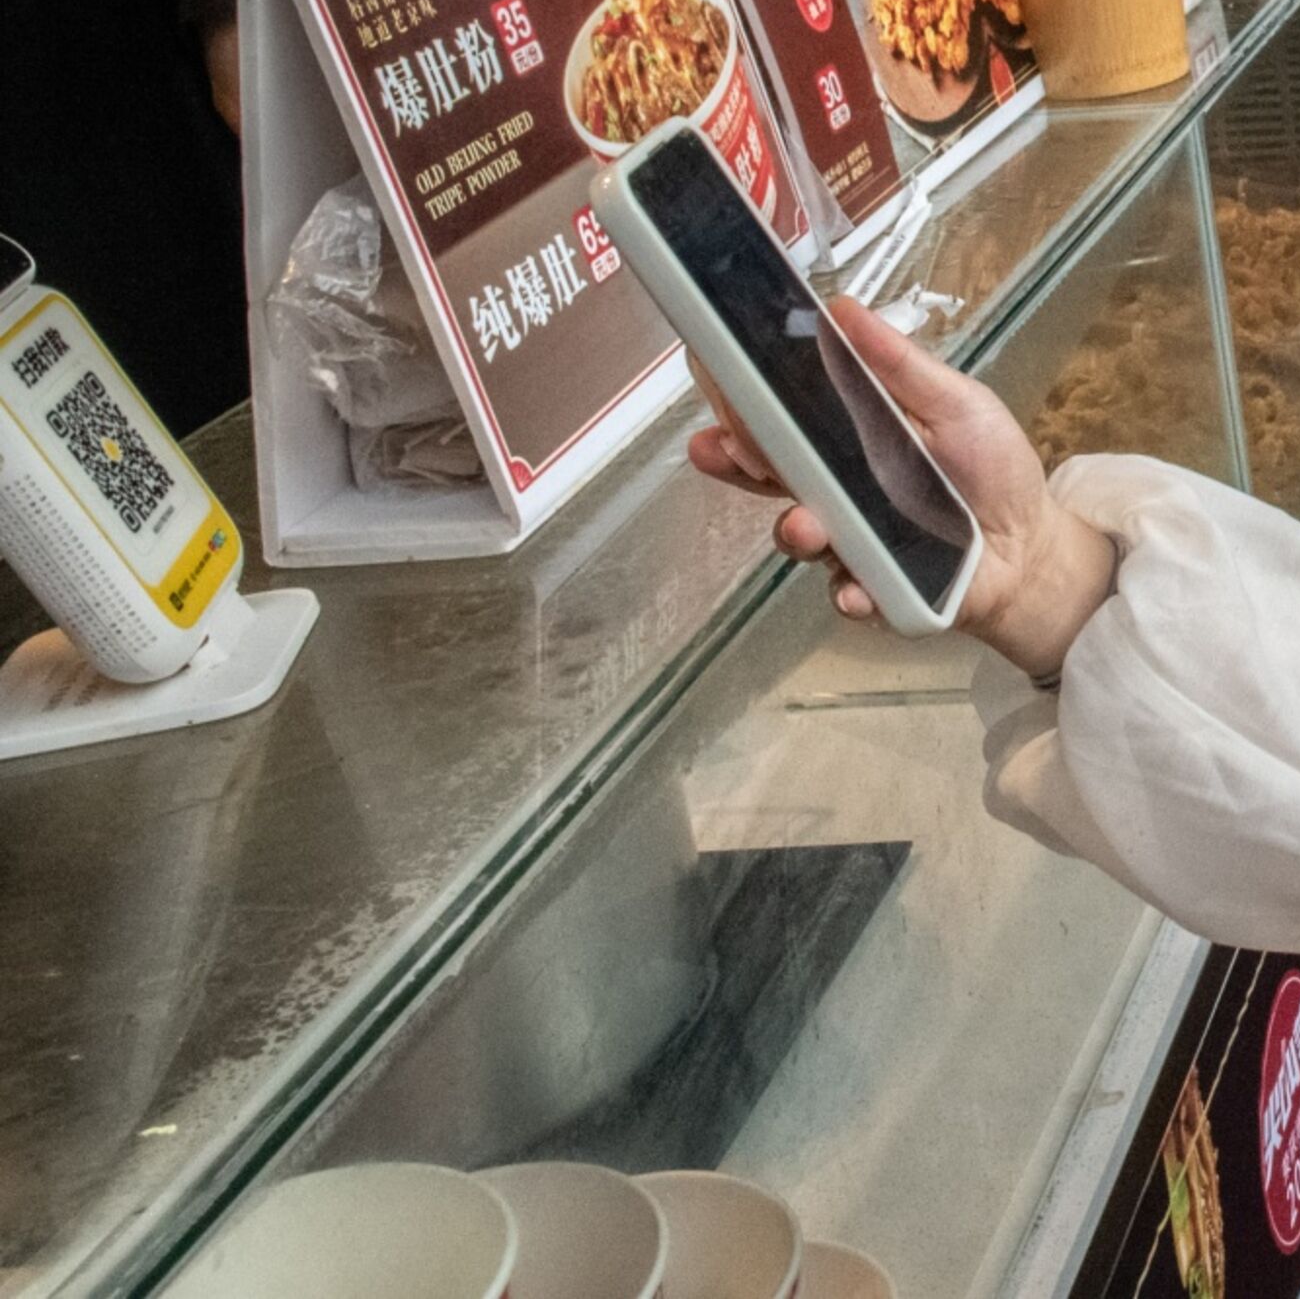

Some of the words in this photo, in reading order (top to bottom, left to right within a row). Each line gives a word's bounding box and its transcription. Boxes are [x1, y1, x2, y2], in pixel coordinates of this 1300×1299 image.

[496, 0, 533, 46] 35
[374, 17, 504, 138] 爆肚粉
[818, 70, 843, 109] 30
[415, 163, 446, 195] OLD
[446, 132, 498, 181] BEIJING
[496, 110, 535, 147] FRIED
[424, 183, 468, 221] TRIPE
[467, 149, 523, 197] POWDER
[576, 209, 610, 255] 65
[468, 233, 588, 363] 纯爆肚
[11, 326, 70, 389] 扫我付款
